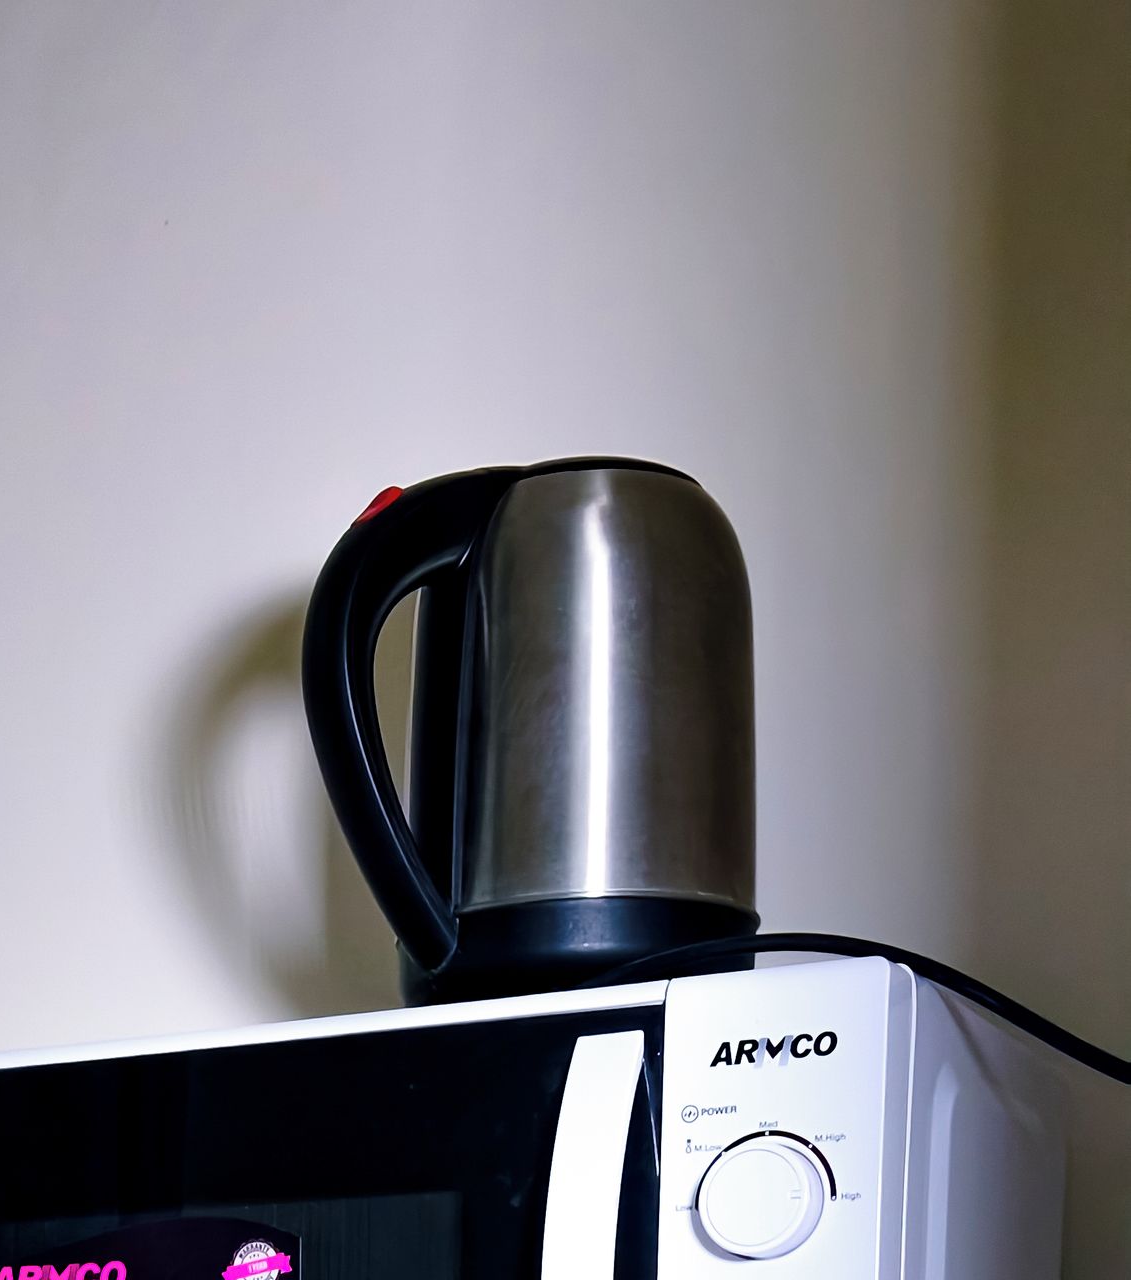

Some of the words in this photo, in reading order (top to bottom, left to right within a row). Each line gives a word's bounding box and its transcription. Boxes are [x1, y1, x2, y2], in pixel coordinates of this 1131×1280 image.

[710, 1031, 838, 1067] ARMCO
[701, 1105, 737, 1116] POWER
[841, 1192, 861, 1201] High
